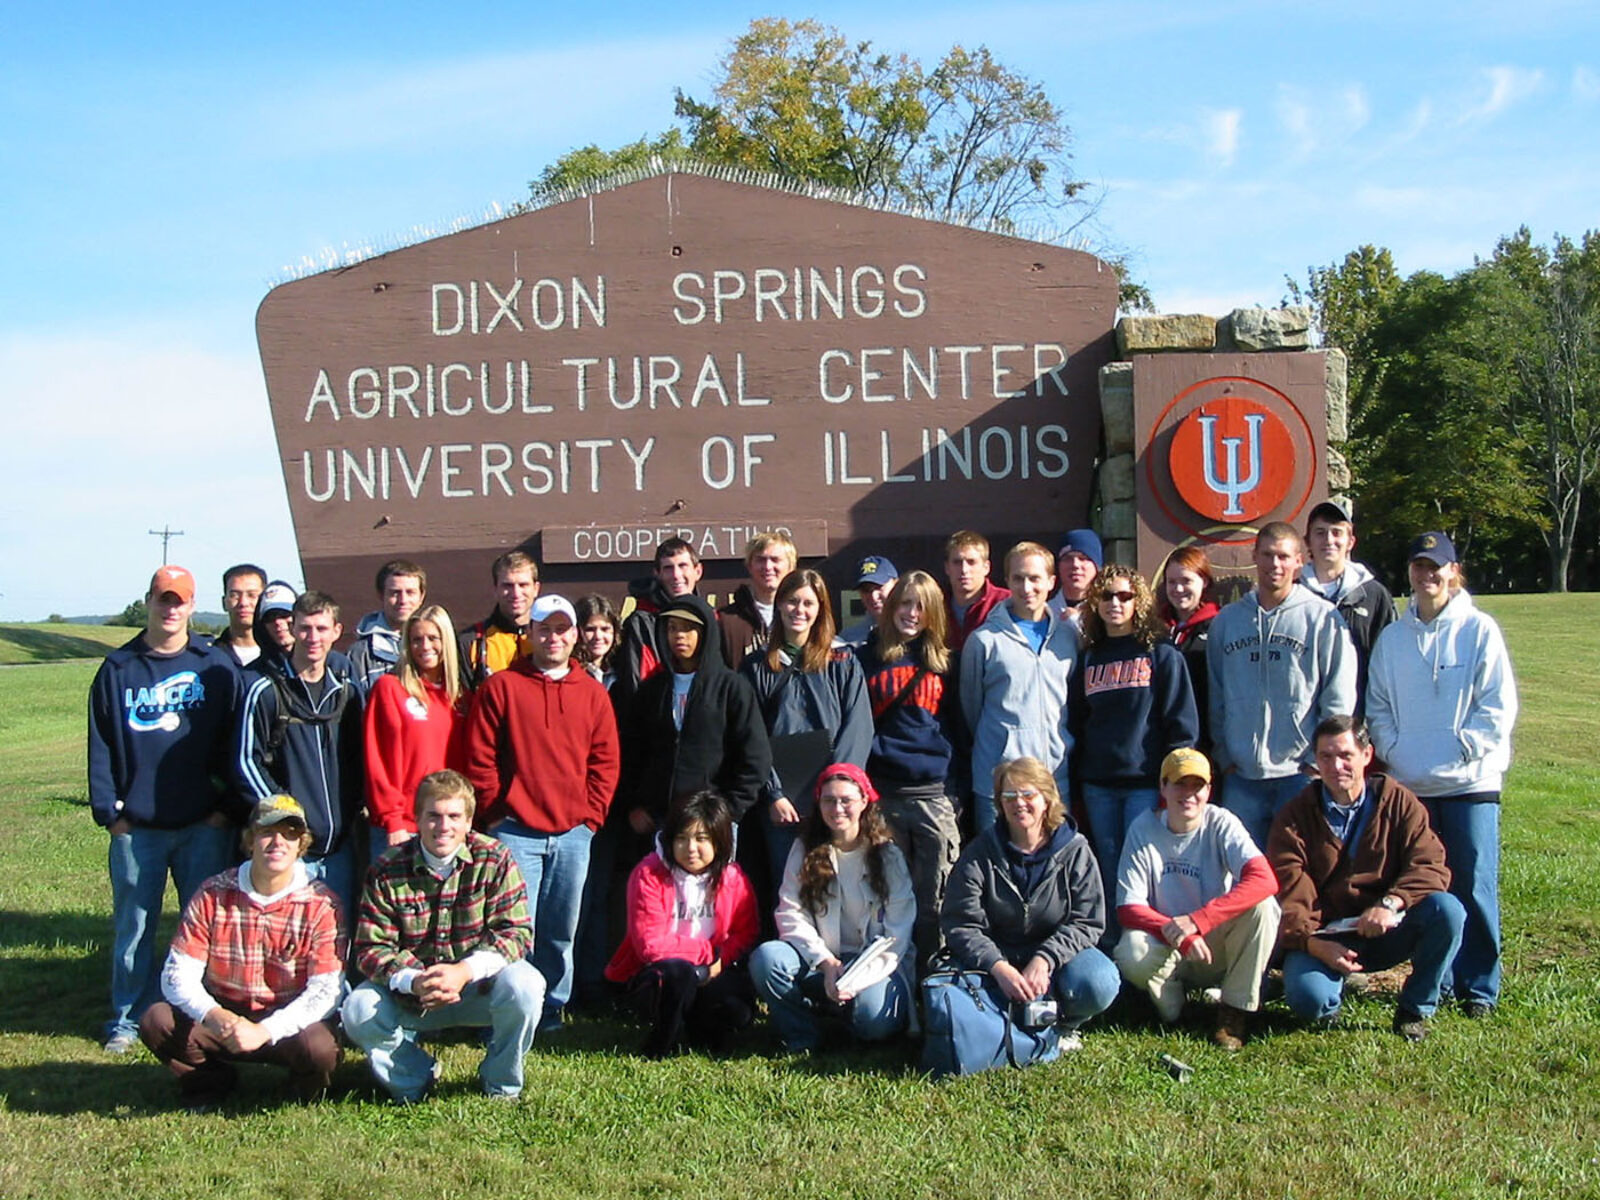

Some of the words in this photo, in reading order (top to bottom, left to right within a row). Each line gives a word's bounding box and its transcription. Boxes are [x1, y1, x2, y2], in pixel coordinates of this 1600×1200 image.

[432, 276, 605, 335] DIXON
[673, 264, 927, 325] SPRINGS
[304, 353, 770, 422] AGRICULTURAL
[819, 344, 1069, 404] CENTER
[303, 437, 655, 502] UNIVERSITY
[702, 434, 775, 489] OF
[825, 425, 1070, 485] ILLINOIS
[574, 526, 792, 559] COOPATI
[1086, 657, 1152, 690] LLINOIS
[125, 682, 205, 707] LANCER
[138, 699, 201, 713] ASEBALL
